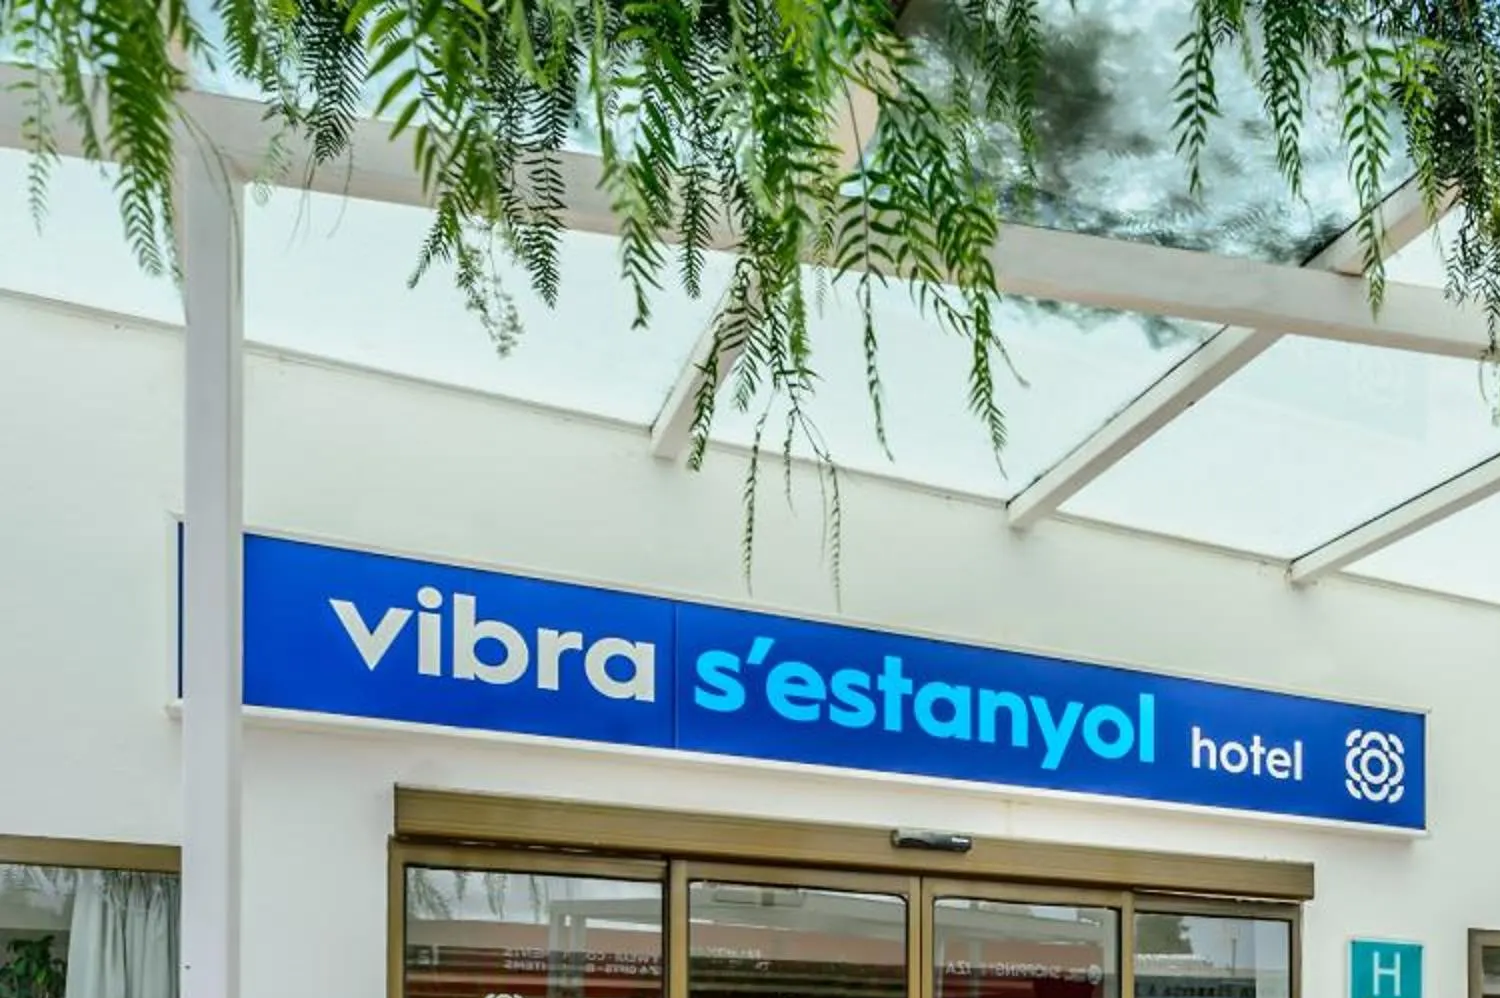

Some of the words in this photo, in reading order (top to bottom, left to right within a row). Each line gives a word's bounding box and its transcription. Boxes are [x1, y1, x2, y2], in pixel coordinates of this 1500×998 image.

[329, 587, 656, 702] vibra
[1191, 727, 1302, 780] hotel
[1372, 951, 1402, 997] H
